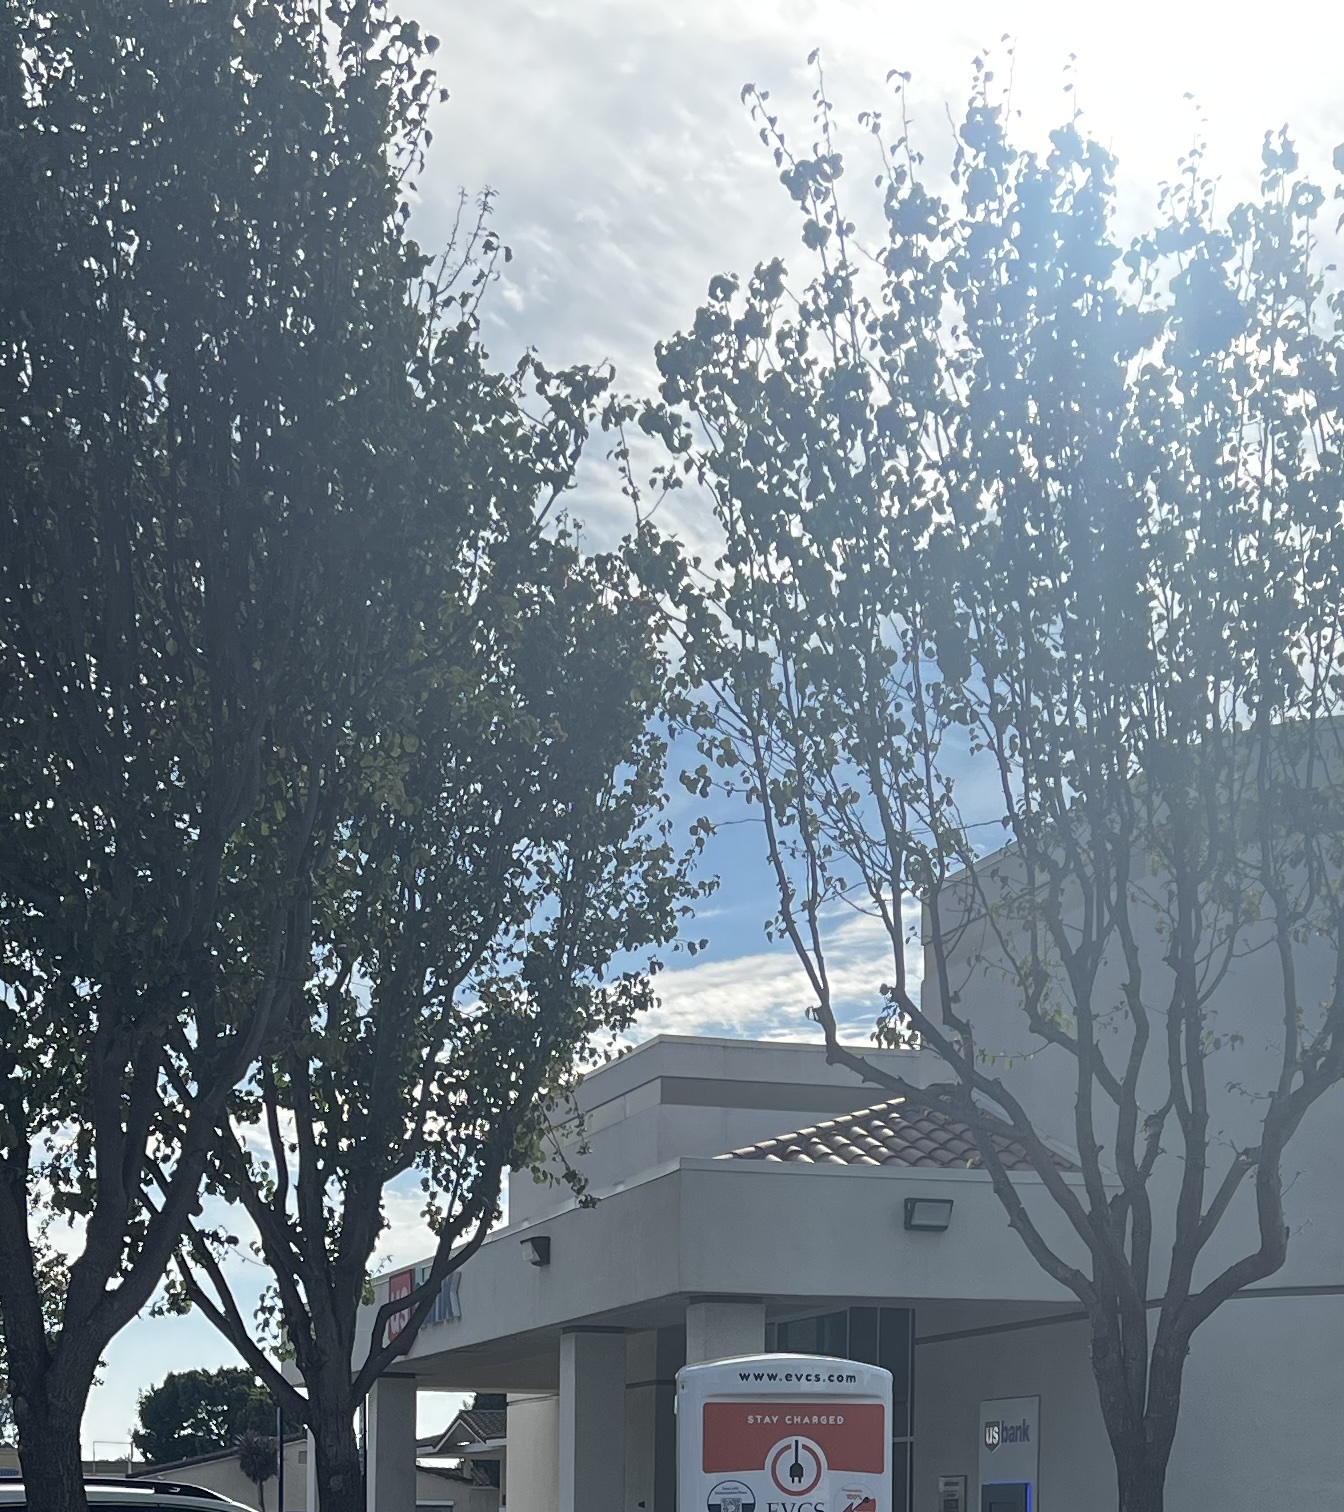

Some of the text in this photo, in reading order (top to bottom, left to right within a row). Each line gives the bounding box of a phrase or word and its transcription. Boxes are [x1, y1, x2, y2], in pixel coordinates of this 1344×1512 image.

[739, 1372, 857, 1384] www.evcs.com
[747, 1415, 845, 1425] STAY CHARGED
[1001, 1419, 1030, 1443] bank
